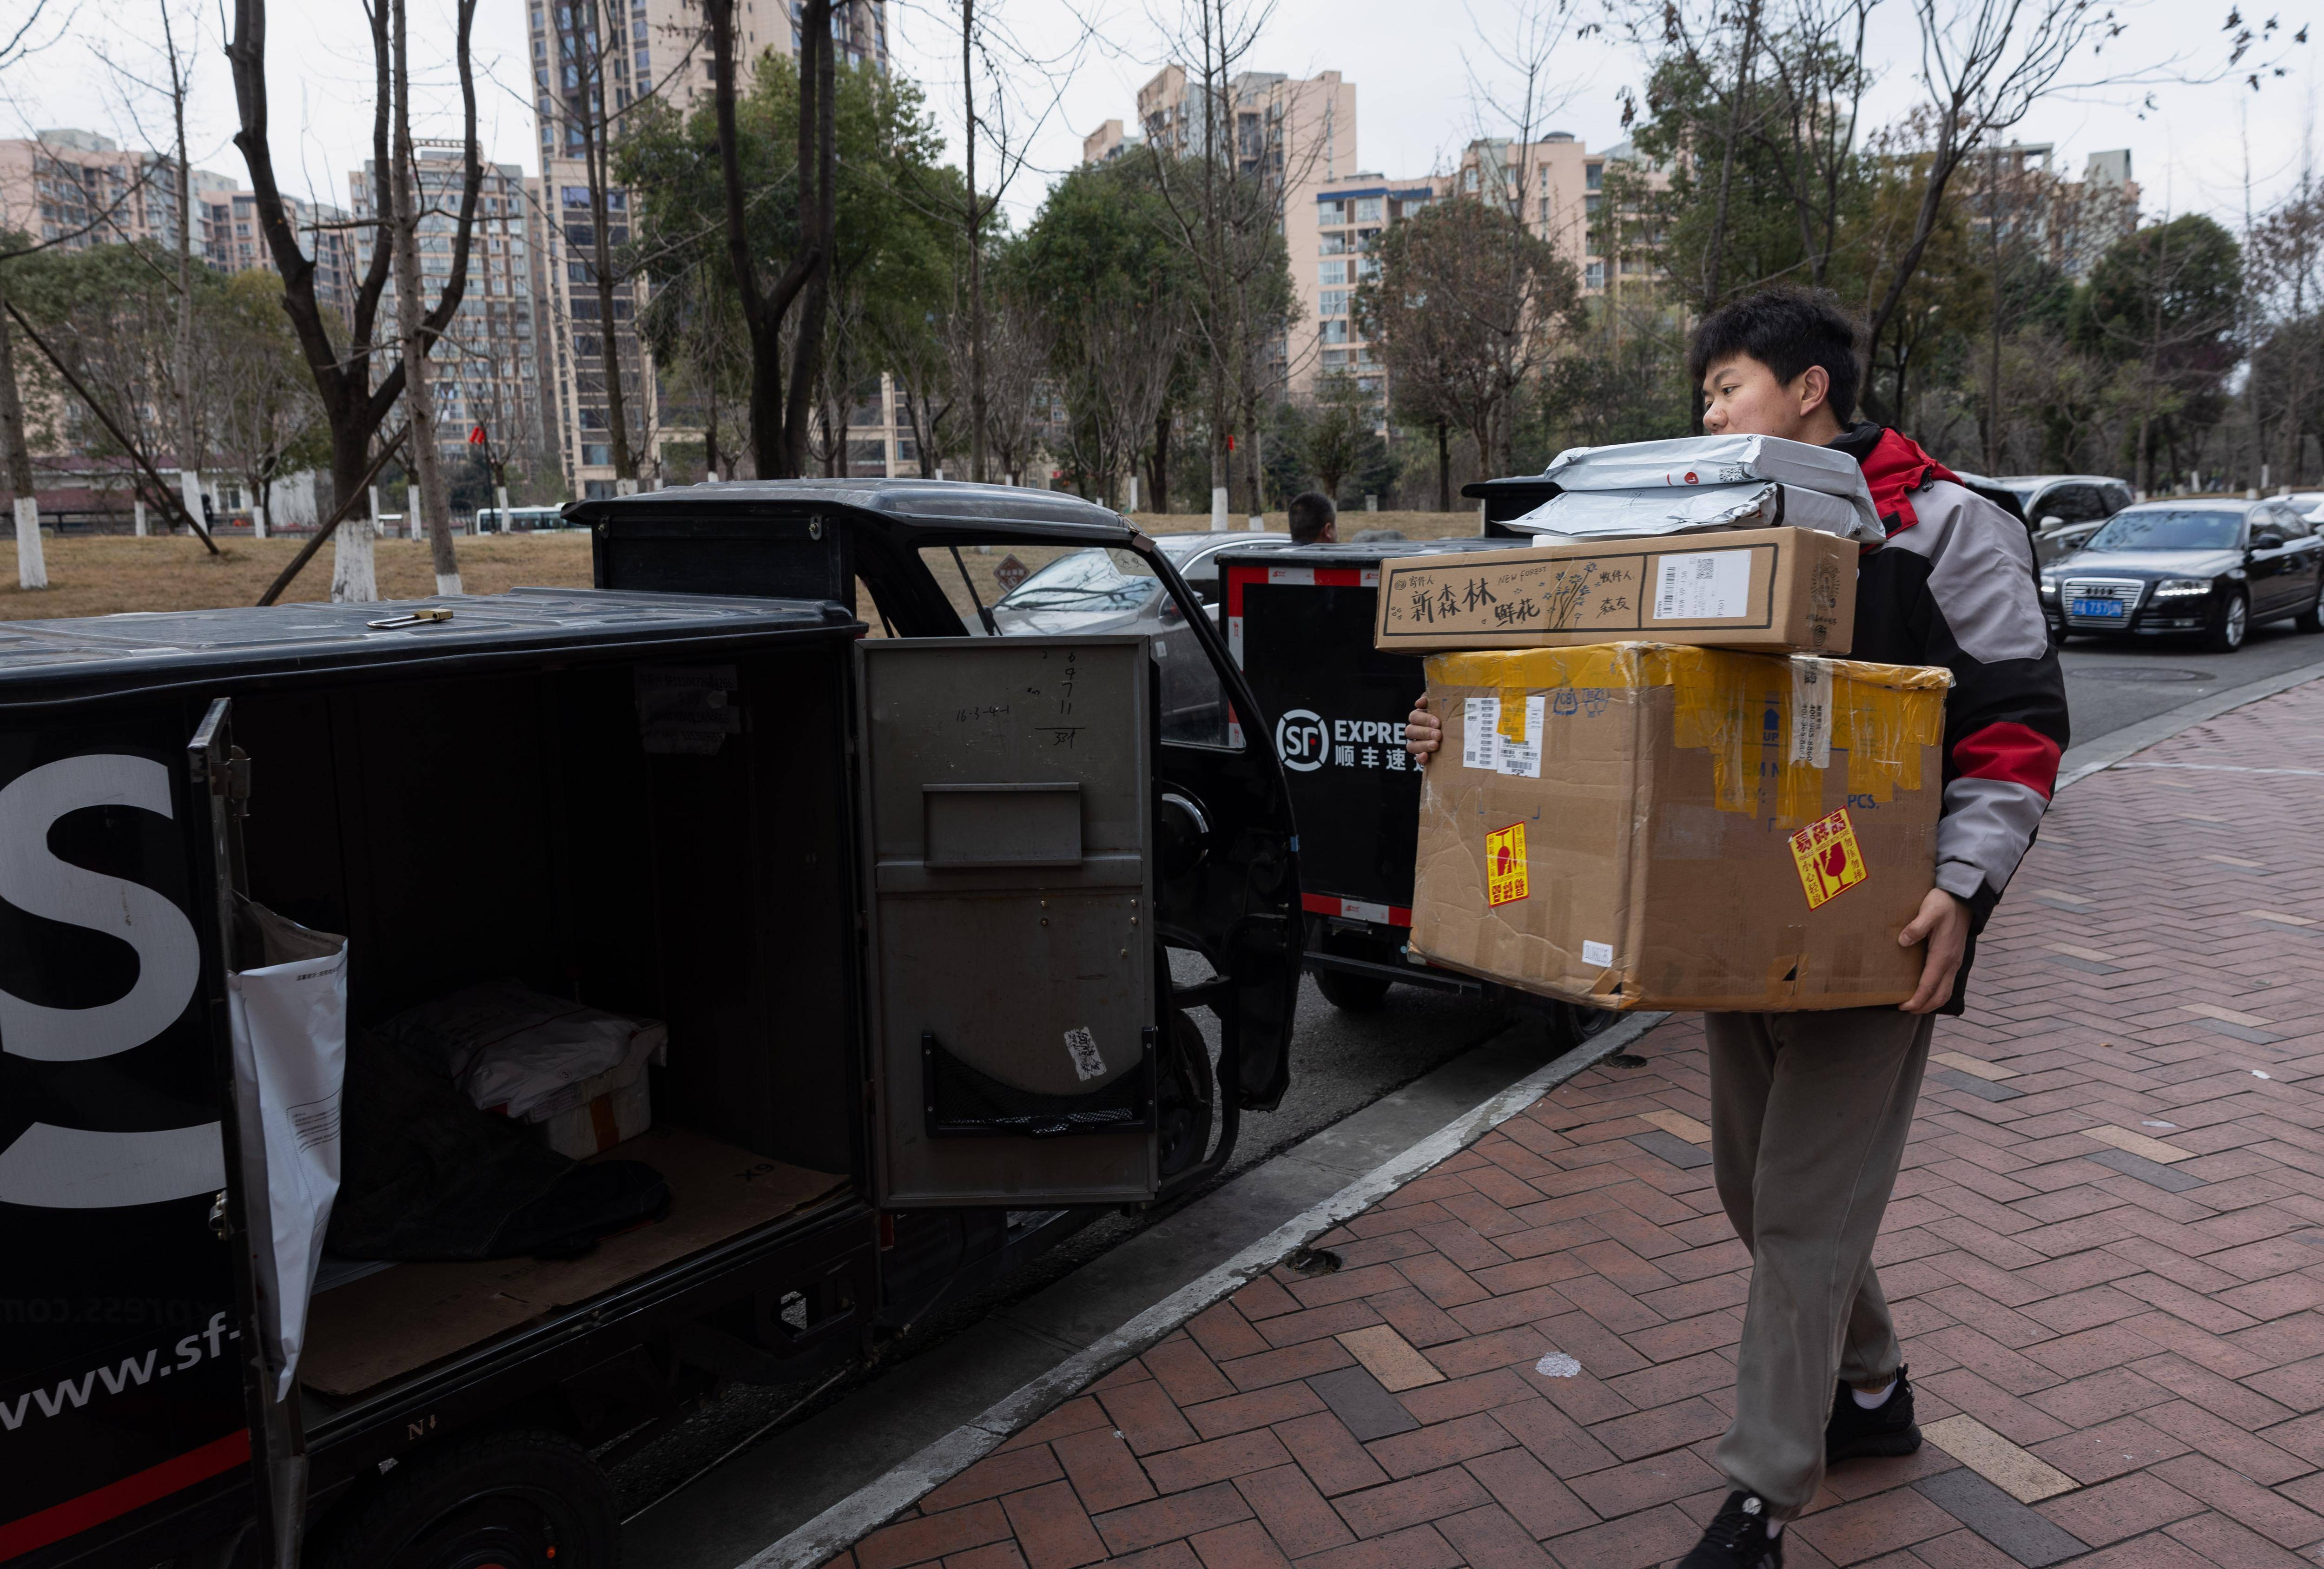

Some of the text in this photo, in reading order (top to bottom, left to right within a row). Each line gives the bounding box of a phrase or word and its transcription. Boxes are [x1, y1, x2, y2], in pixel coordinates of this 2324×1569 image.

[1495, 598, 1541, 627] 鲜花
[1335, 720, 1406, 744] EXPRE
[1763, 732, 1779, 741] UP
[1796, 812, 1847, 853] 易碎品
